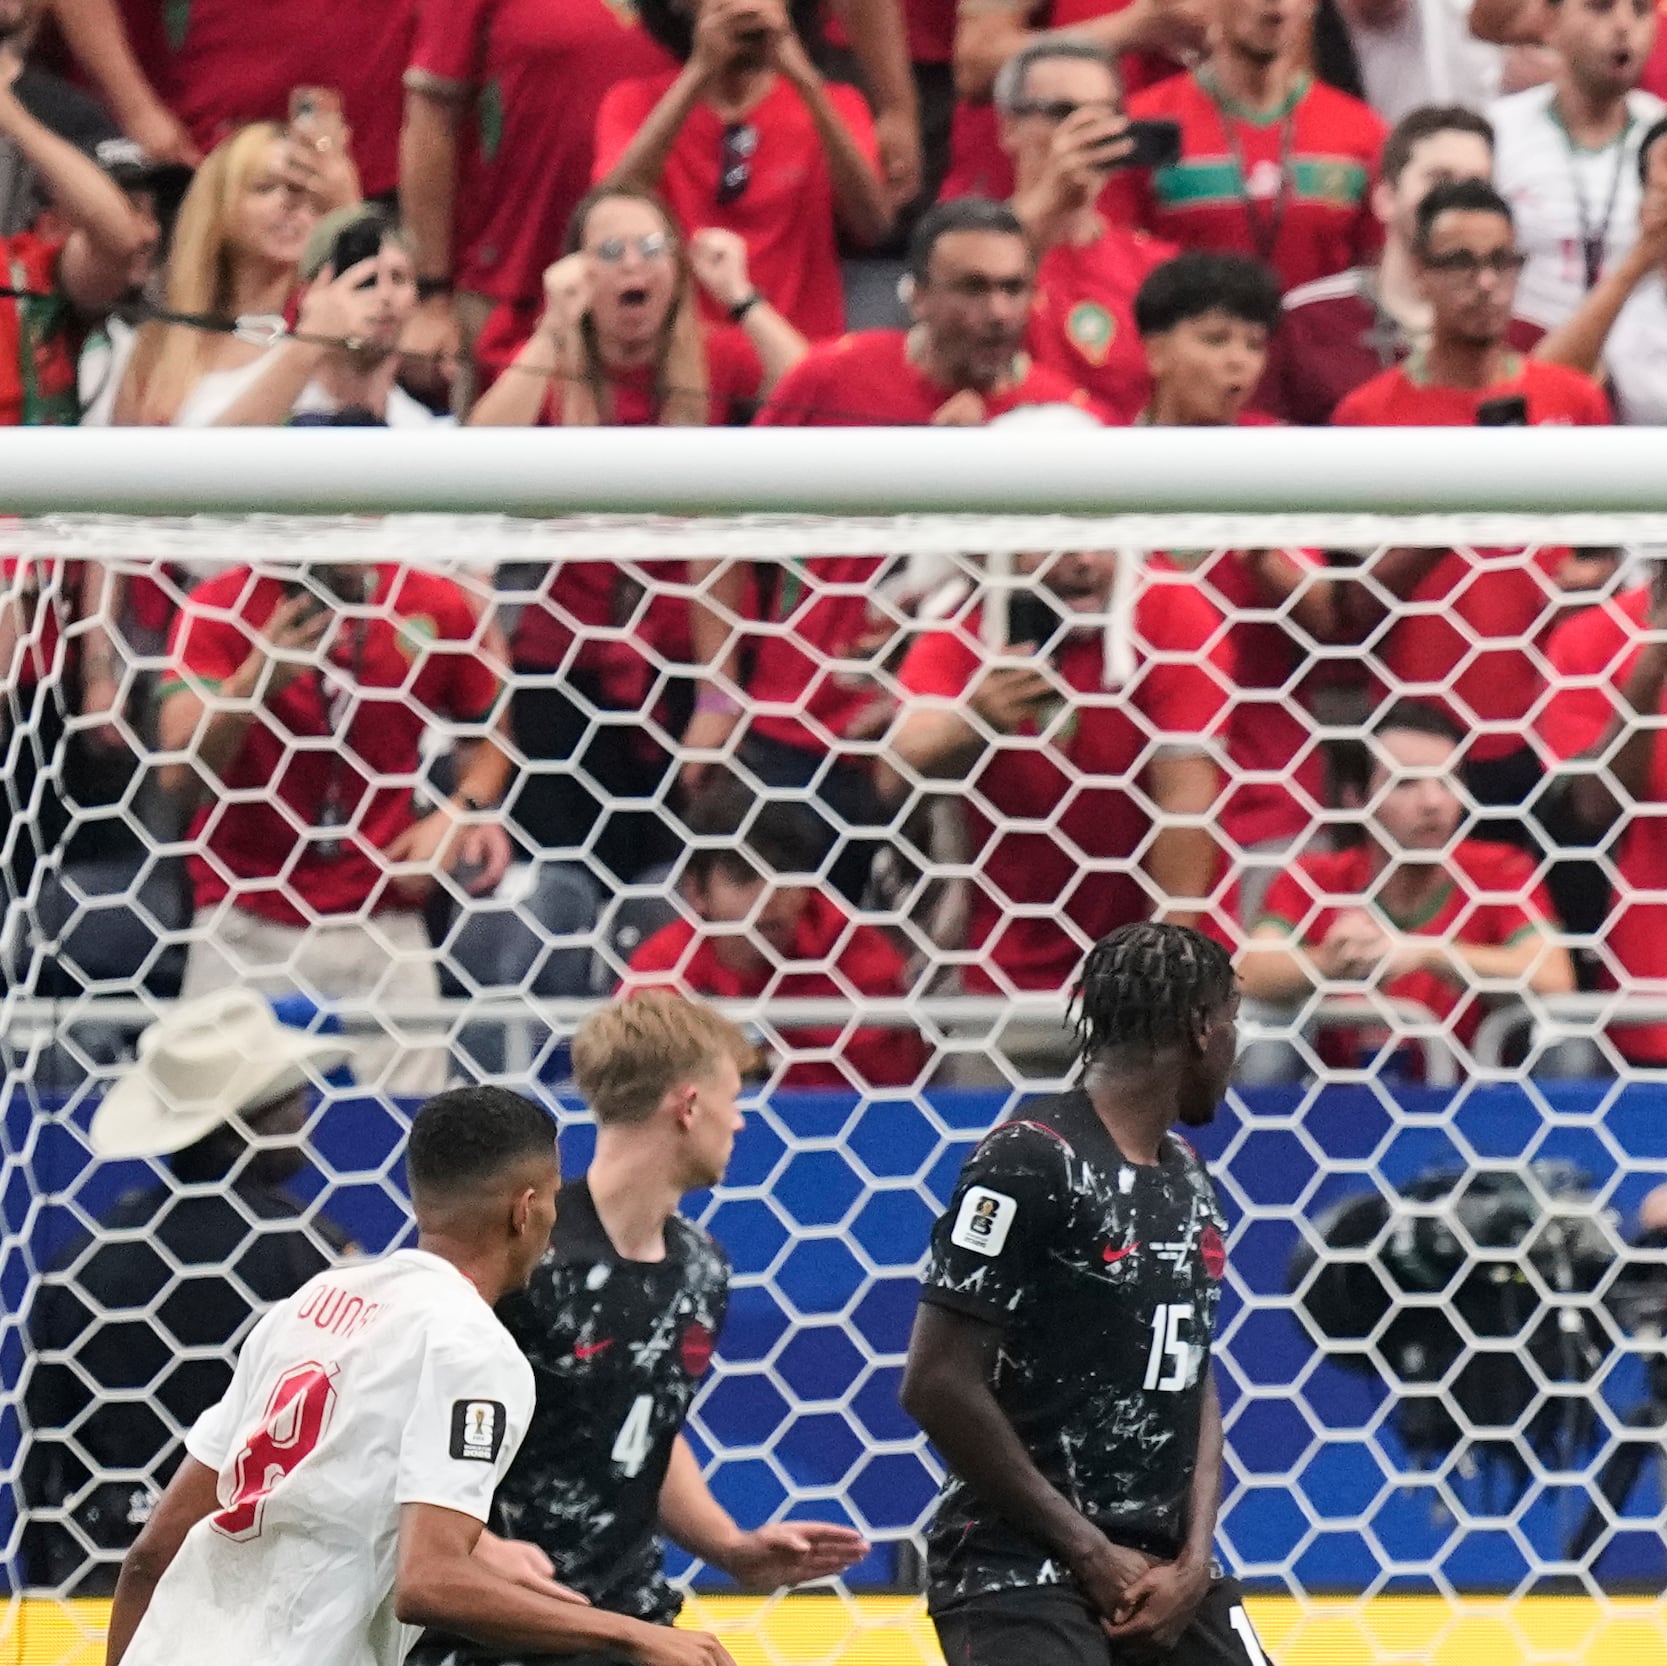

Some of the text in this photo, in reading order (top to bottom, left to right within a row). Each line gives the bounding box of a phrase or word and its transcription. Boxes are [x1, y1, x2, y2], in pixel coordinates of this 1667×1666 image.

[1143, 1303, 1194, 1391] 15
[209, 1360, 340, 1543] 8
[611, 1394, 654, 1478] 4
